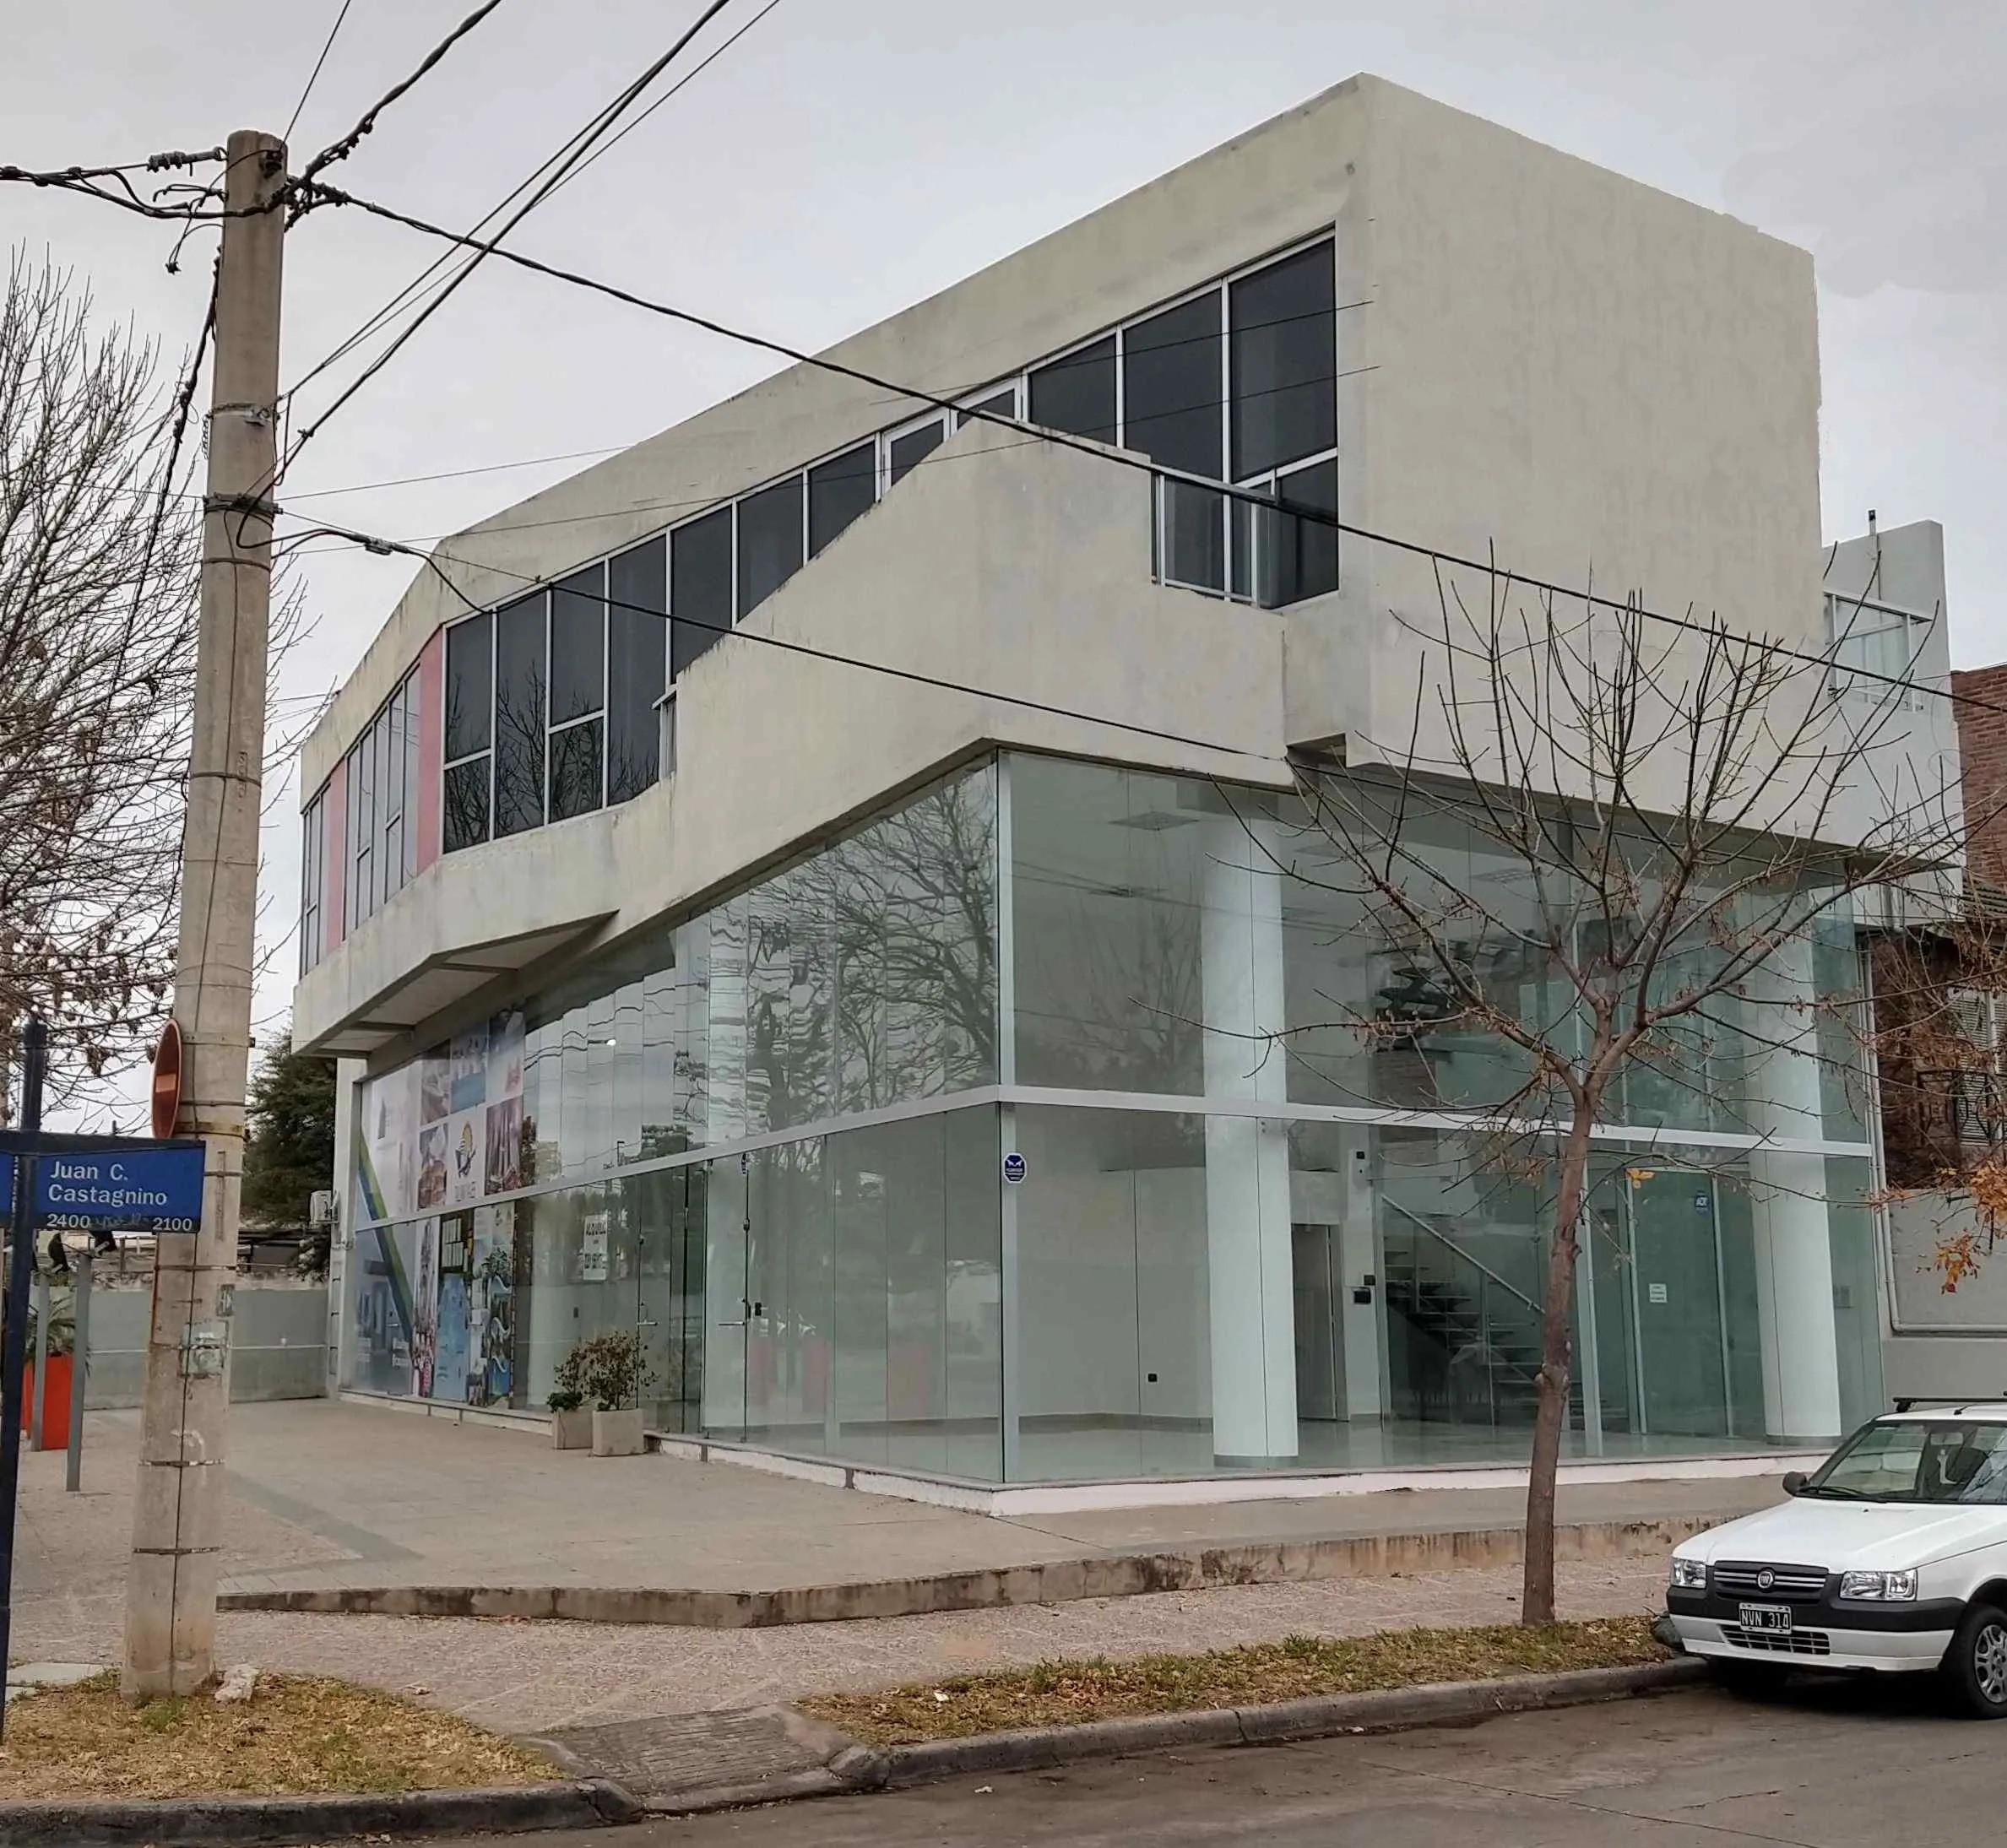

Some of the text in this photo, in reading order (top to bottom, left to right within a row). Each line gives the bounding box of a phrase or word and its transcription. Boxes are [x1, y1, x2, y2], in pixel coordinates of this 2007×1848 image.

[50, 1162, 129, 1181] Juan C.
[48, 1184, 168, 1207] Castagnino
[46, 1213, 90, 1227] 2400
[152, 1217, 193, 1232] 2100
[1741, 1610, 1789, 1628] NVN 314
